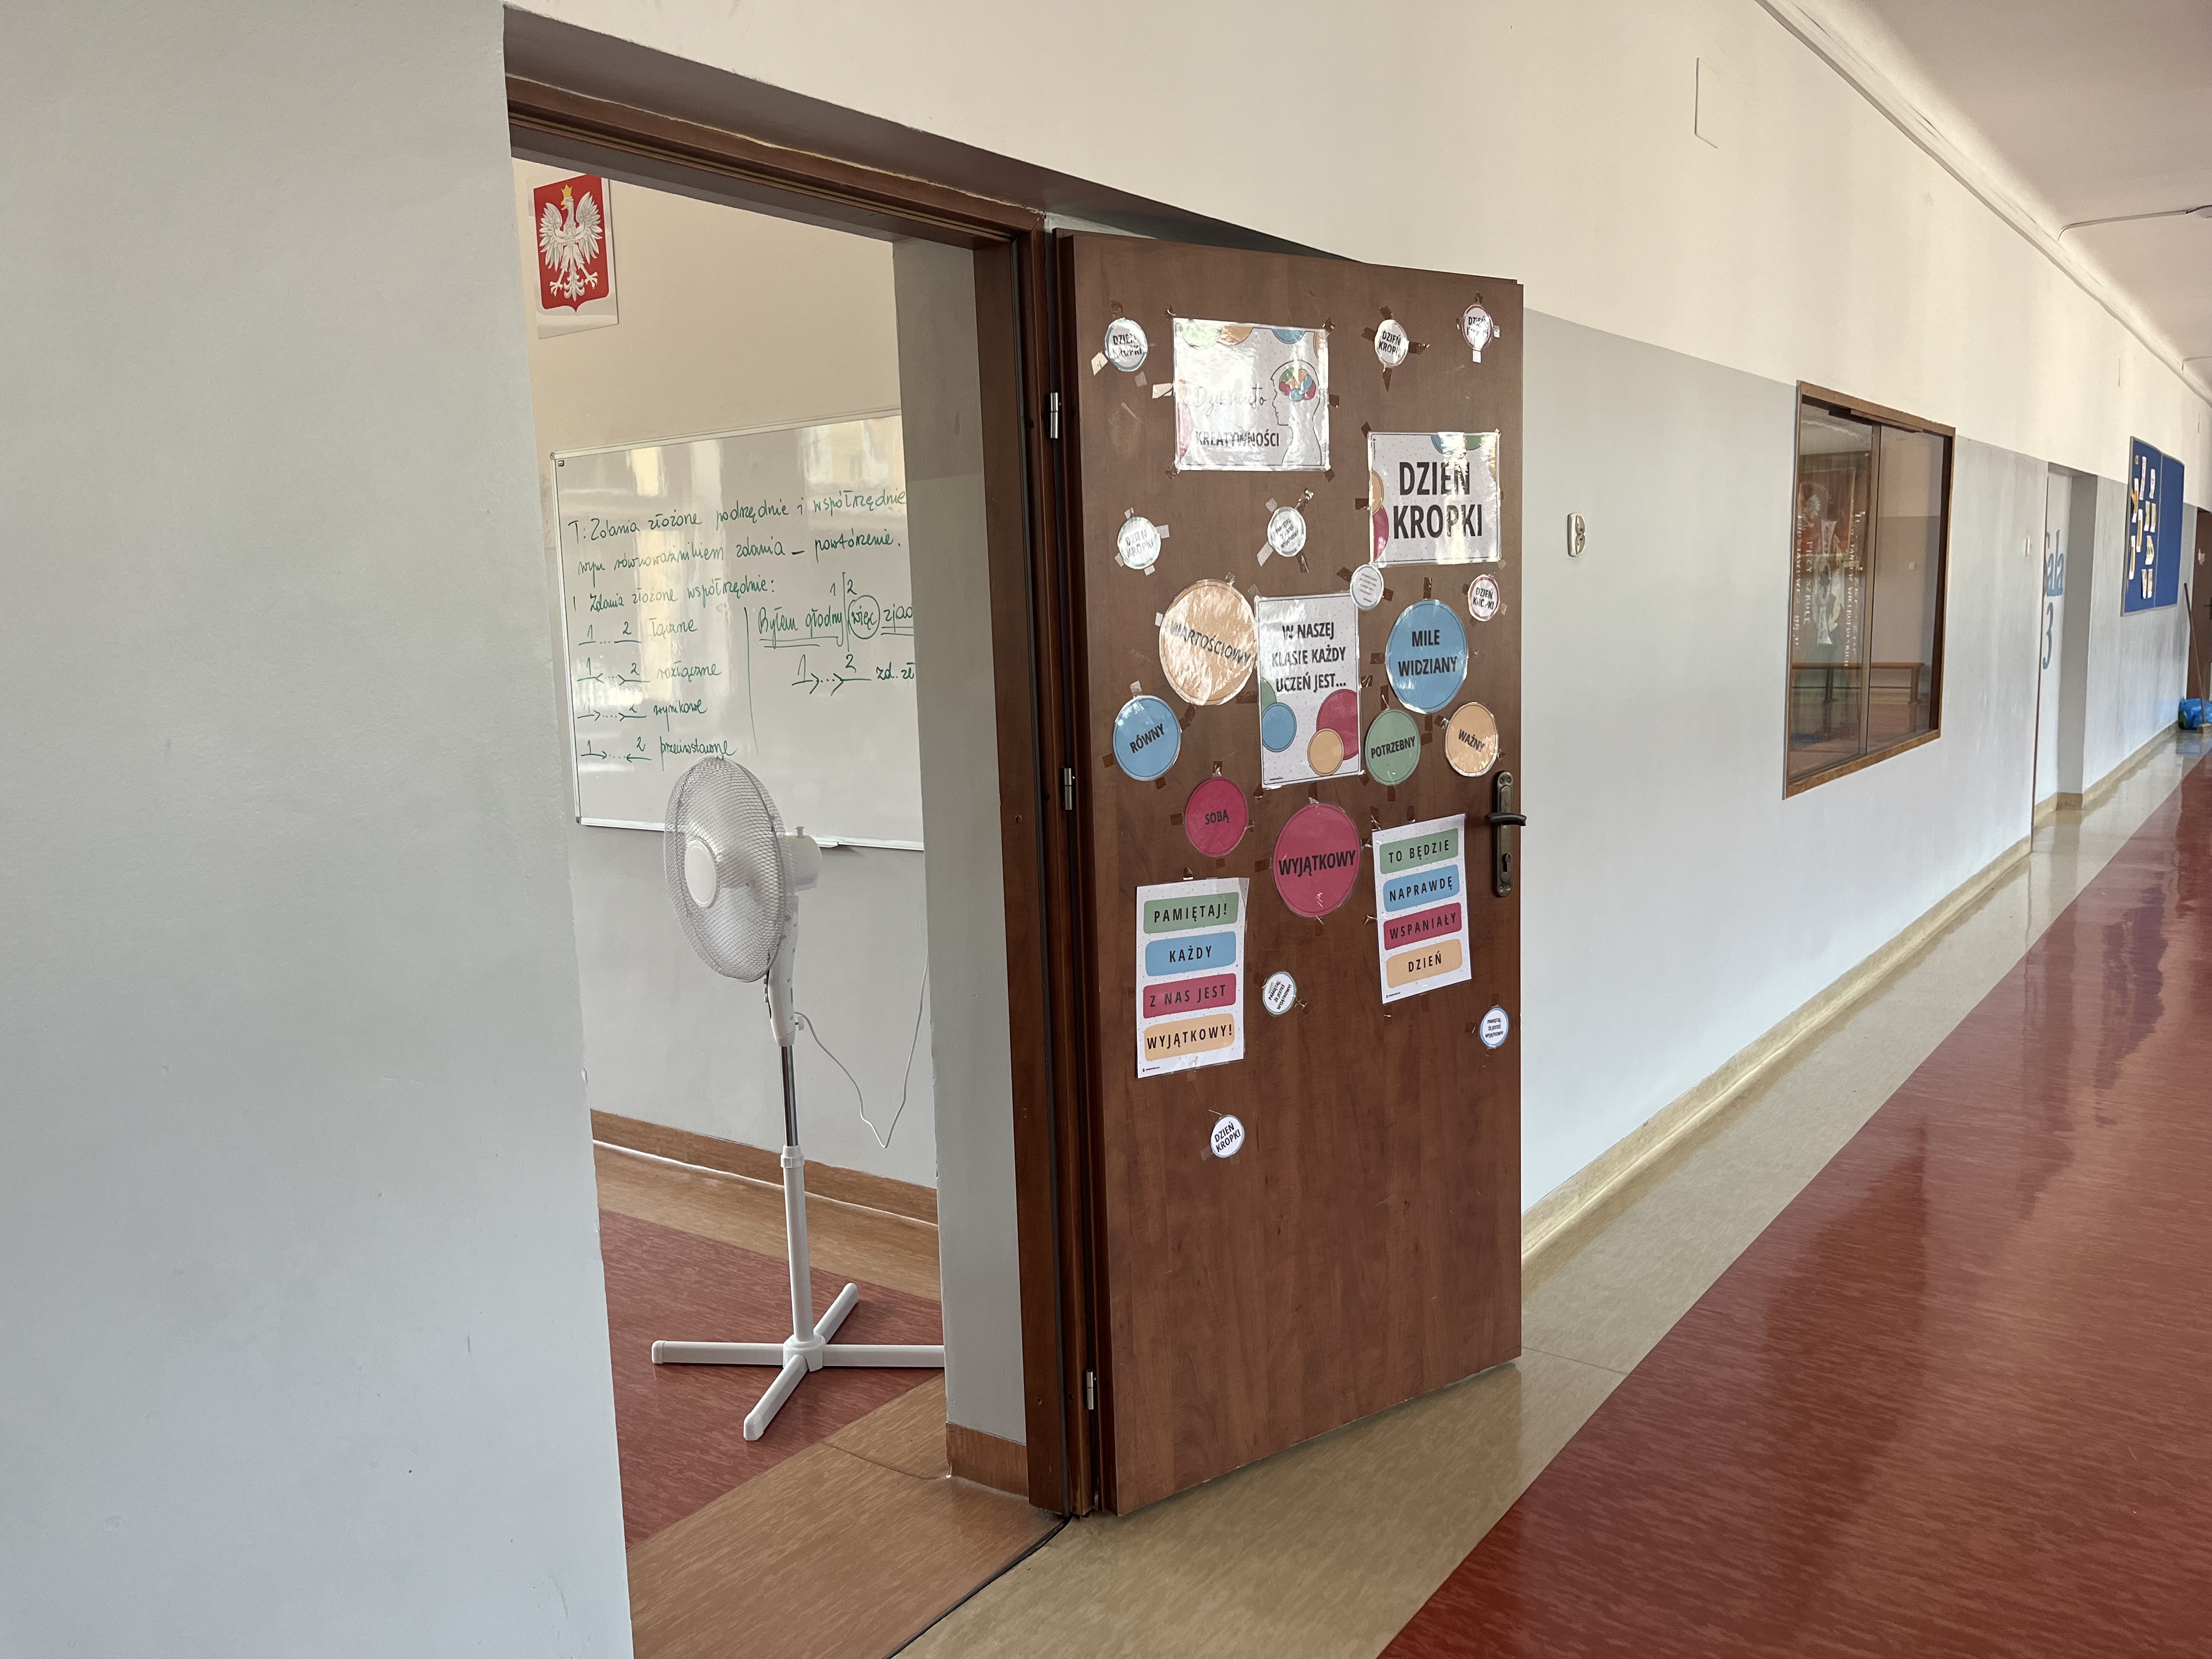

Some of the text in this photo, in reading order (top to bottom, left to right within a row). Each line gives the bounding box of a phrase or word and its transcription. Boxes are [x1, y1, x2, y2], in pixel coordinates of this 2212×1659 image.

[1113, 332, 1137, 345] DZIE
[1379, 341, 1401, 358] KROP
[1383, 331, 1401, 346] DZIEŃ
[591, 518, 640, 541] Zdania
[648, 509, 703, 531] złożone
[716, 499, 789, 531] podrzędnie
[797, 497, 805, 515] i
[814, 488, 907, 517] współrzędnie
[1393, 504, 1482, 539] KROPKI
[737, 535, 786, 558] zdania
[847, 579, 857, 595] 2
[1476, 587, 1493, 599] DZIEŃ
[587, 624, 593, 641] 1
[623, 621, 632, 635] 2
[1282, 622, 1334, 640] W NASZEJ
[1412, 629, 1440, 647] MILE
[2042, 602, 2054, 669] 3
[1170, 620, 1251, 665] WARTOŚCIOWY
[586, 657, 591, 676] 1
[630, 663, 640, 675] 2
[845, 654, 856, 673] 2
[1272, 644, 1346, 667] KLASIE KAŻDY
[1398, 656, 1458, 677] WIDZIANY
[1276, 672, 1346, 693] UCZEŃ JEST...
[587, 740, 591, 754] 1
[636, 737, 646, 752] 2
[1130, 723, 1165, 754] RÓWNY
[1370, 736, 1415, 759] POTRZEBNY
[1458, 729, 1486, 753] WAŻNY
[1205, 809, 1229, 825] SOBĄ
[1389, 839, 1449, 864] TO BĘDZIE
[1278, 850, 1356, 877] WYJĄTKOWY
[1389, 876, 1453, 902] NAPRAWDĘ
[1154, 902, 1227, 923] PAMIĘTAJ!
[1389, 912, 1457, 940] WSPANIAŁY
[1169, 944, 1212, 963] KAŻDY
[1408, 950, 1442, 973] DZIEŃ
[1150, 984, 1226, 1008] Z NAS JEST
[1147, 1024, 1233, 1050] WYJĄTKOWY!
[1214, 1121, 1234, 1142] DZIEŃ
[1216, 1129, 1241, 1153] KROPKI
